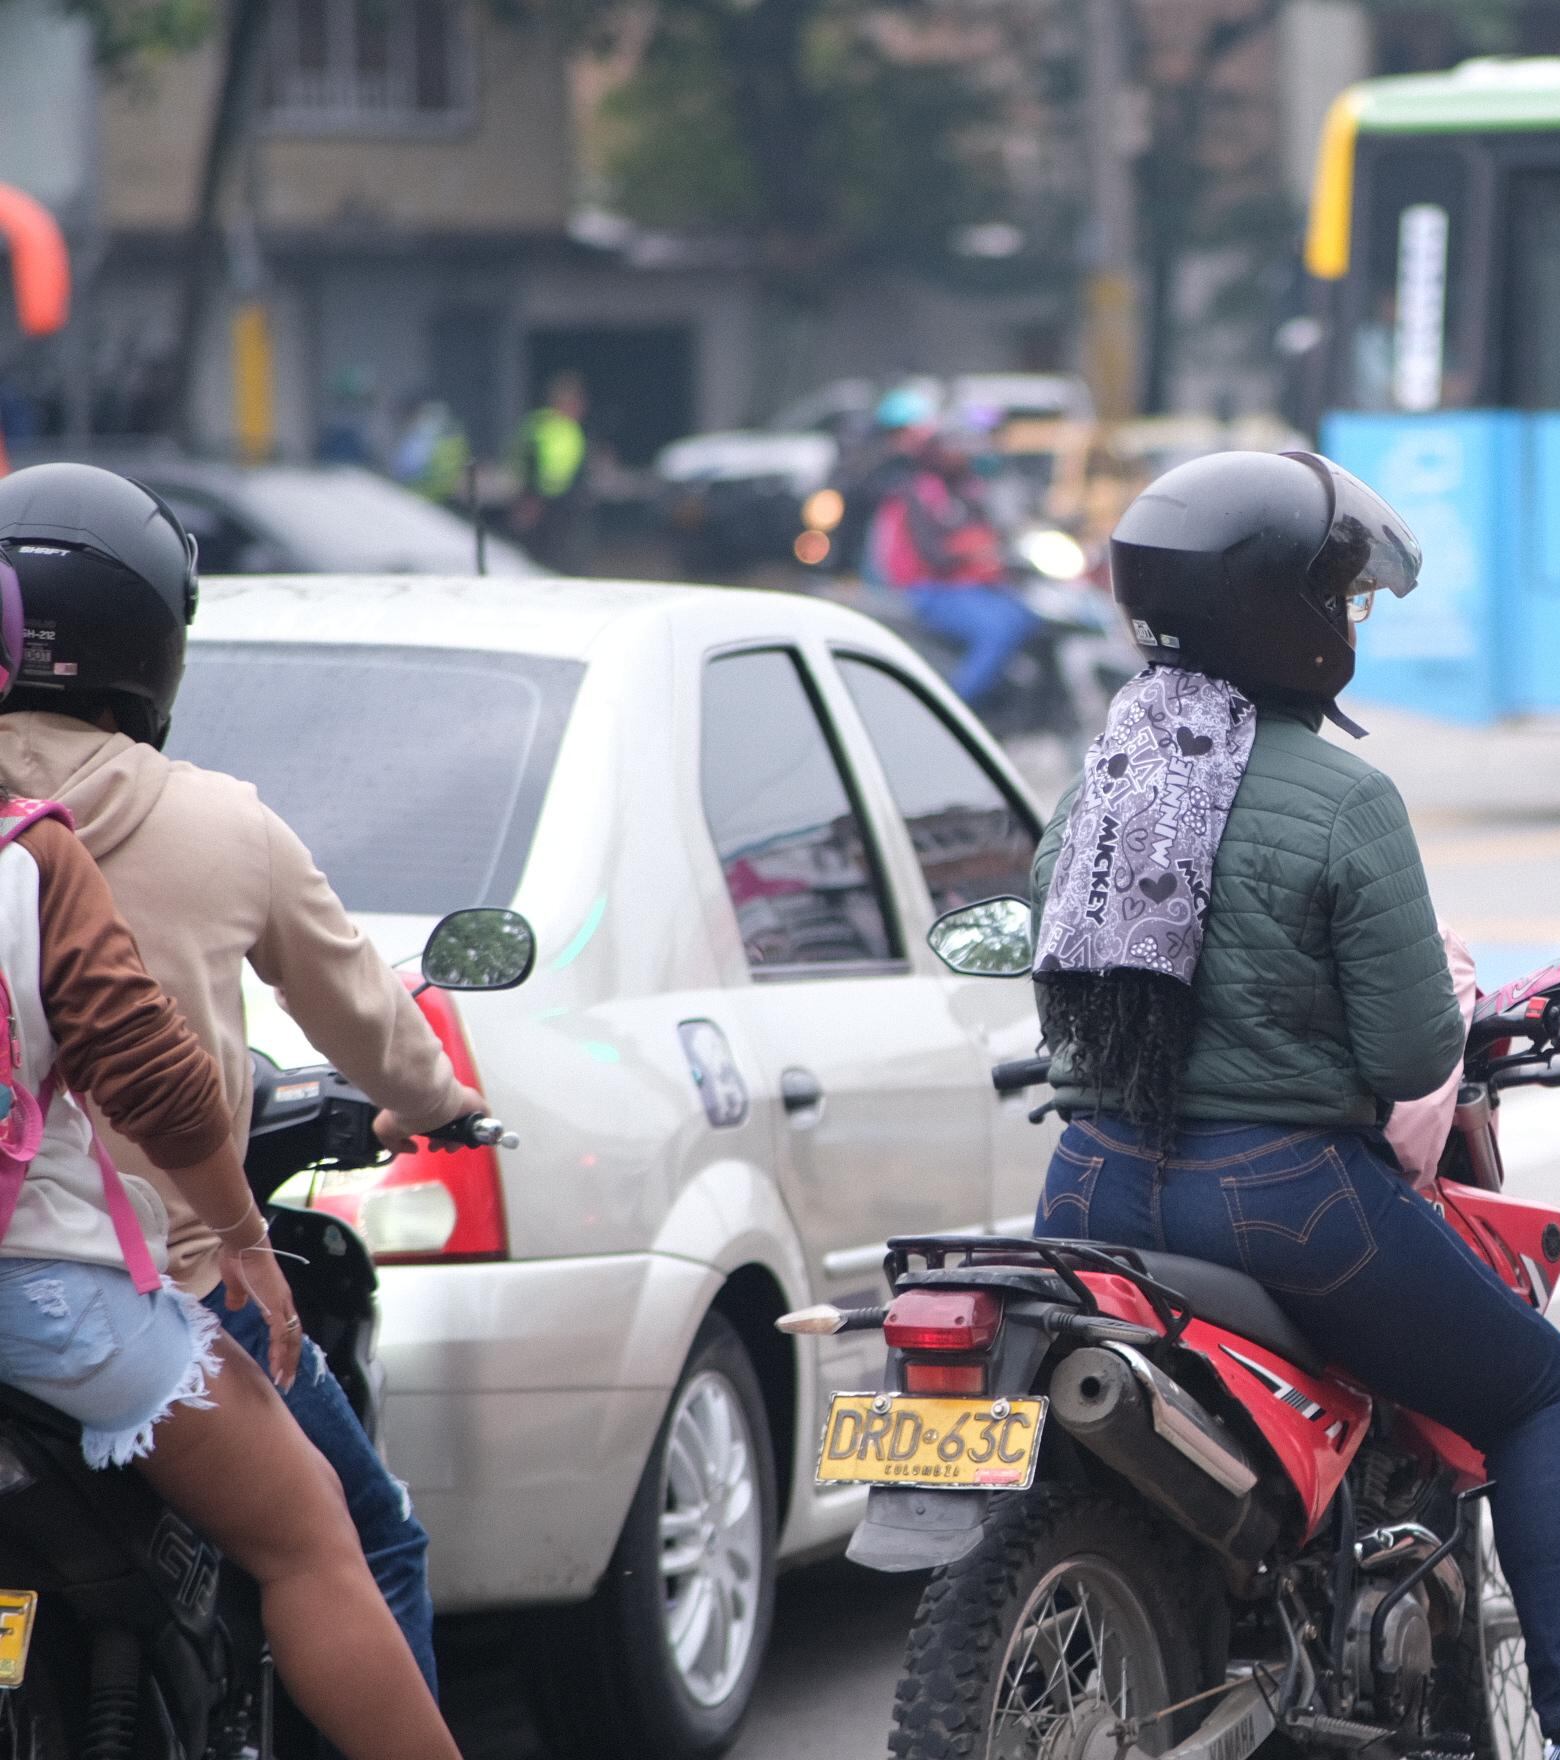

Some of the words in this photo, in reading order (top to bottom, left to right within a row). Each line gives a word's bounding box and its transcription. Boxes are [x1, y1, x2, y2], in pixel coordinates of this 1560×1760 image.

[18, 546, 72, 557] SHAFT
[1150, 755, 1194, 868] MINNIE
[1085, 814, 1121, 929] MICKEY
